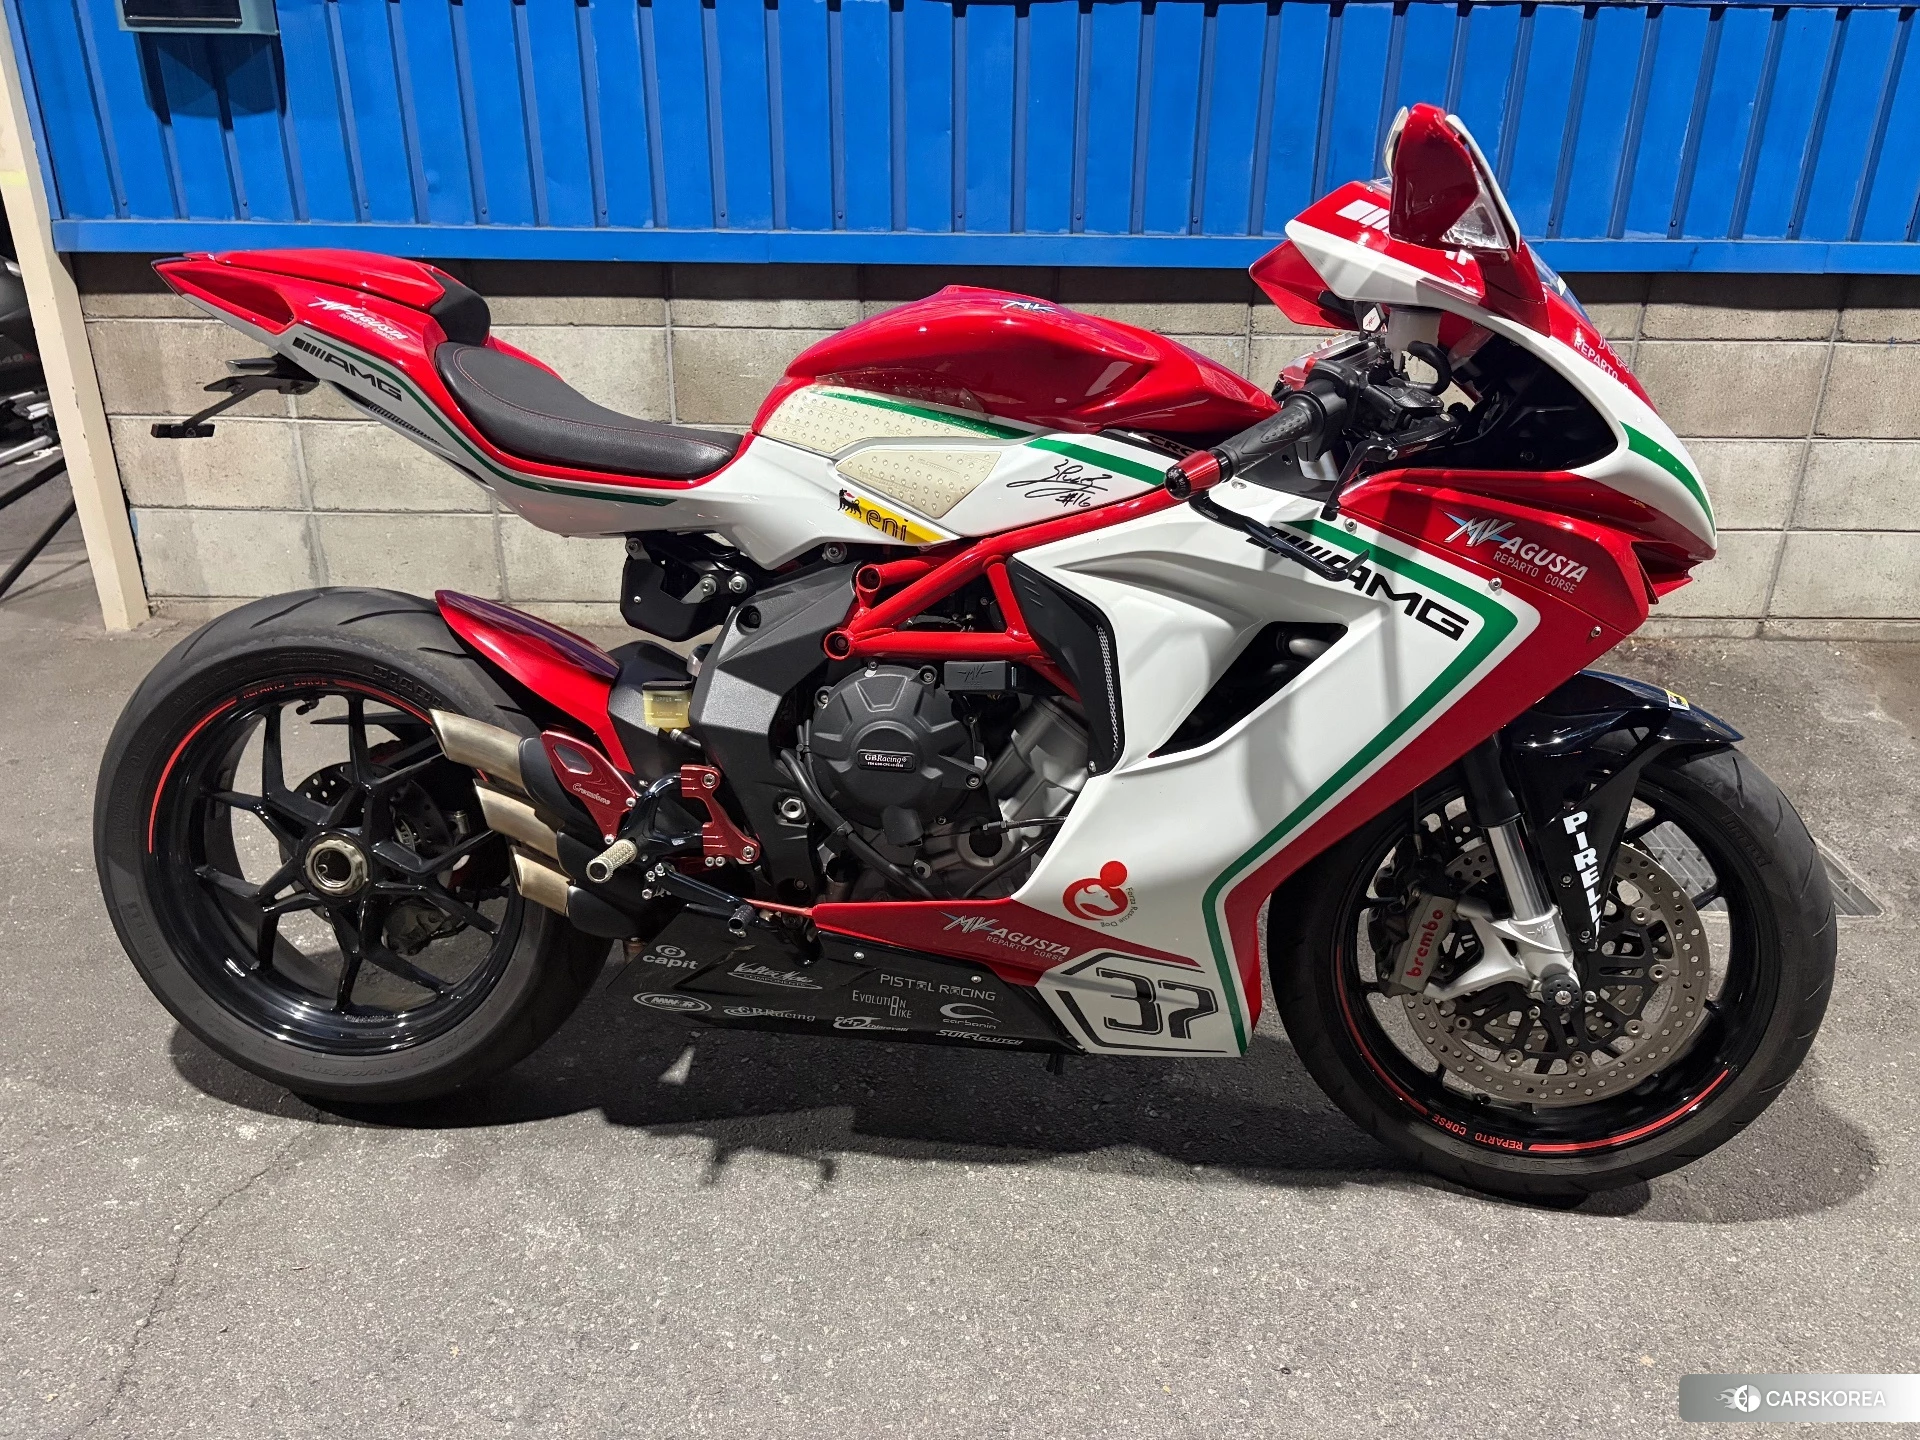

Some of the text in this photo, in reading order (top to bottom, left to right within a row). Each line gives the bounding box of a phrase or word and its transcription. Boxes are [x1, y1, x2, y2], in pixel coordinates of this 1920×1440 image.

[324, 352, 403, 402] AMG
[866, 509, 909, 541] eni
[1493, 551, 1578, 594] REPARTO CORSE
[1499, 536, 1589, 583] AGUSTA
[1331, 554, 1470, 641] AMG
[642, 954, 698, 970] capit
[986, 935, 1065, 962] REPARTO CORSE
[990, 927, 1071, 956] AGUSTA
[1406, 909, 1443, 977] brembo
[1095, 966, 1219, 1040] 37
[1431, 1113, 1523, 1150] REPARTO CORSE
